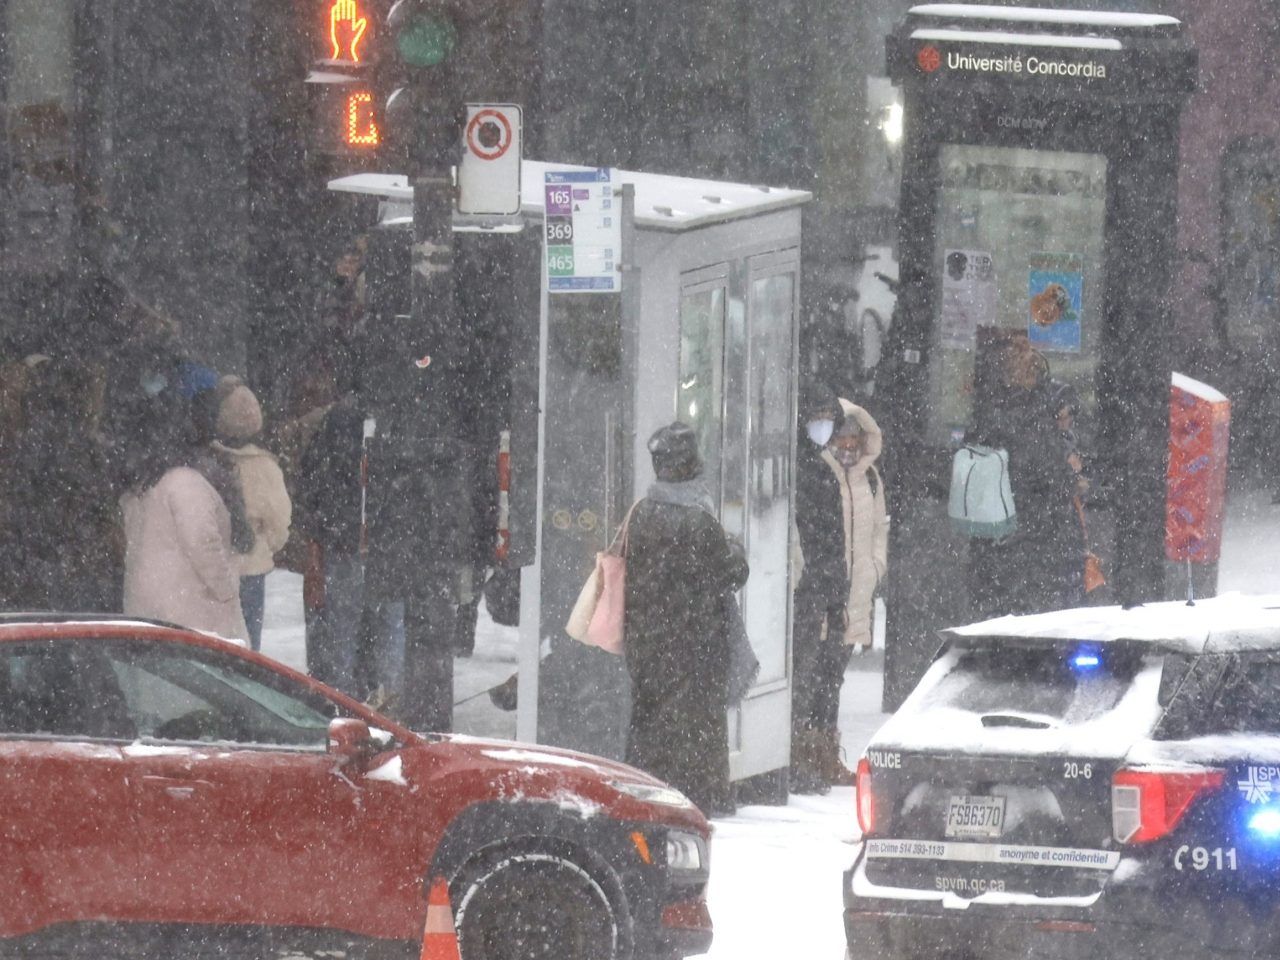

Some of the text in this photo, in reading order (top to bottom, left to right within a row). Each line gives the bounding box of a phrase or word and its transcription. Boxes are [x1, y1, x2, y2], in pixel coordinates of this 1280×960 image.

[947, 52, 1106, 78] Université Concordia
[549, 191, 569, 204] 165
[547, 224, 572, 239] 369
[549, 256, 573, 270] 465
[1064, 763, 1092, 779] 20-6
[900, 844, 912, 854] 514
[1000, 850, 1108, 864] anonyme et confidentiel
[1192, 847, 1237, 870] 911
[935, 877, 1006, 896] spvm.qc.ca
